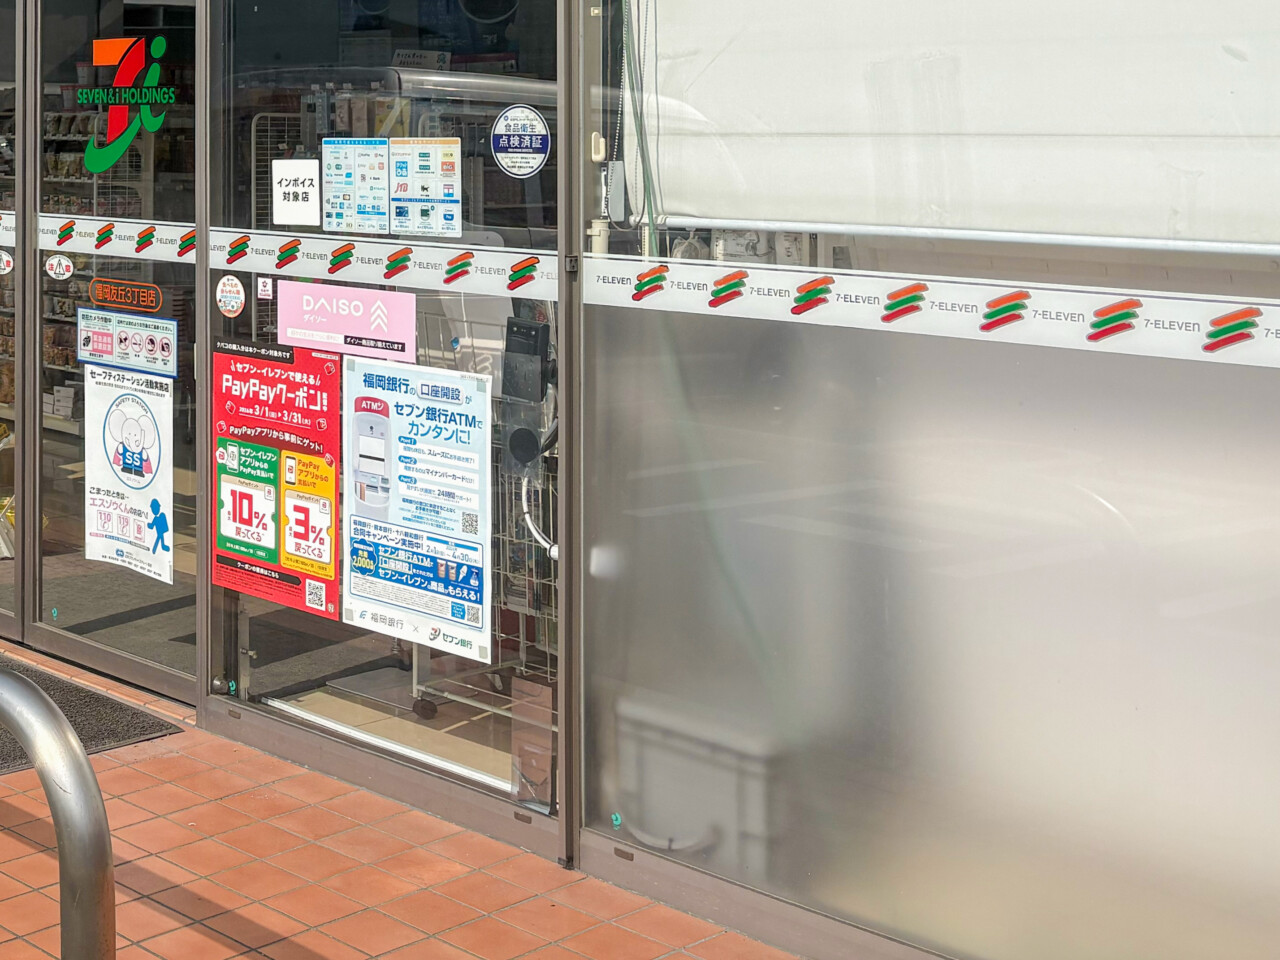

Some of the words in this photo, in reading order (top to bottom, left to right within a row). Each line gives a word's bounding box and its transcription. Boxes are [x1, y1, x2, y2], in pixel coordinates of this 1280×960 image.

[121, 87, 176, 104] HOLDINGS
[504, 123, 537, 133] 食品衛生
[499, 135, 543, 148] 点検済証
[276, 177, 315, 189] インボイス
[282, 191, 310, 202] 対象店
[303, 313, 327, 323] ダイソー
[394, 402, 483, 429] セブン銀行ATMで
[408, 420, 471, 445] カンタンに!
[125, 452, 140, 466] SS
[240, 456, 269, 470] アプリからの
[297, 459, 320, 471] PayPay
[297, 468, 329, 482] アプリからの
[99, 511, 111, 522] 110
[118, 515, 129, 527] 119
[371, 612, 404, 630] 福岡銀行
[442, 632, 473, 650] セブン銀行
